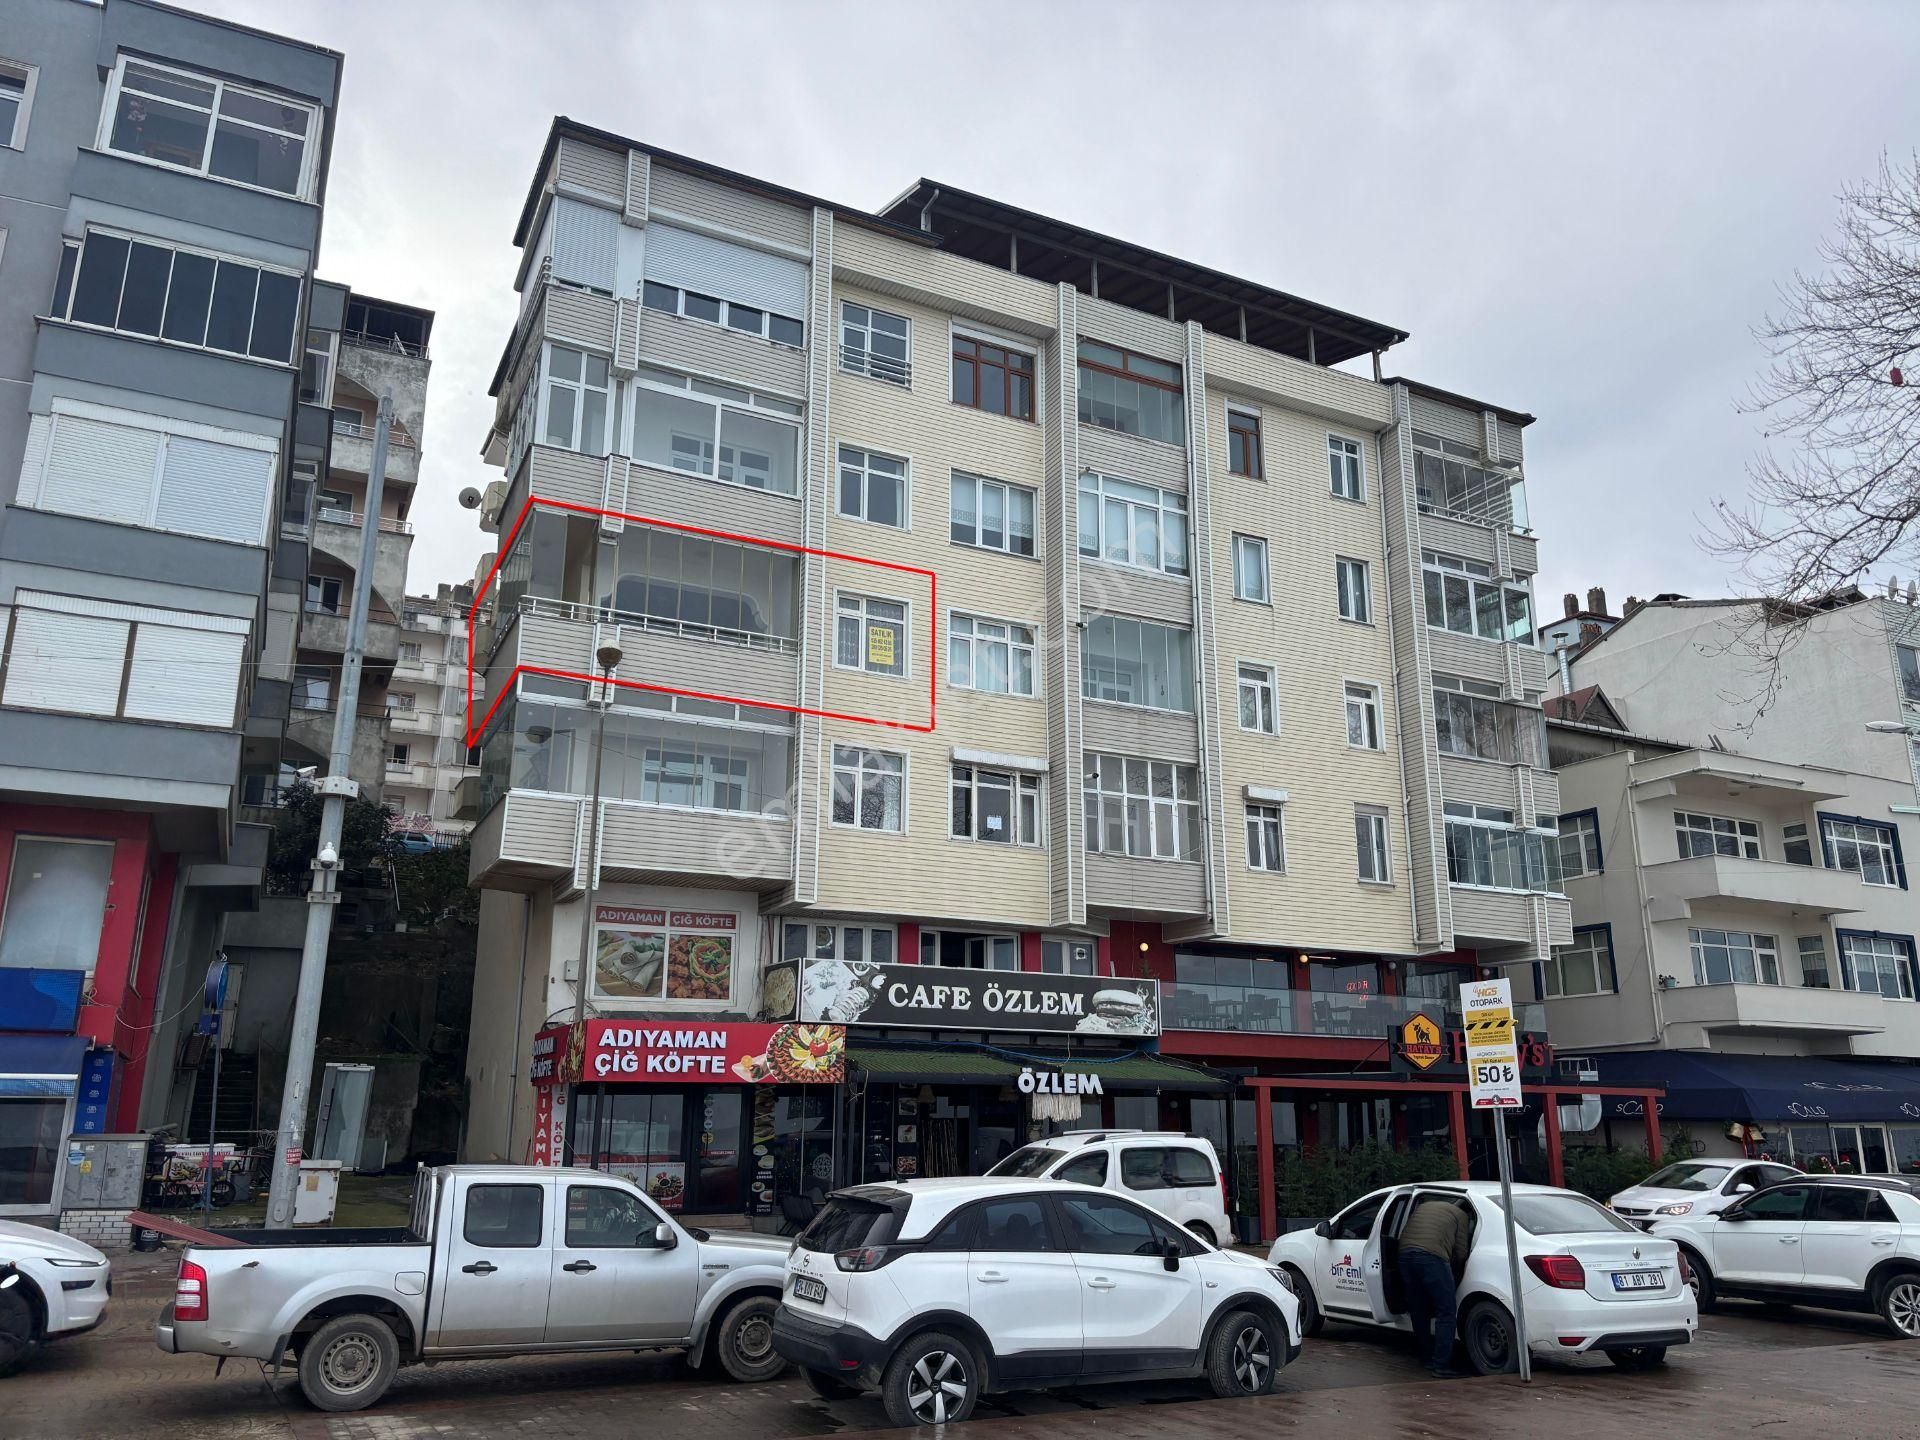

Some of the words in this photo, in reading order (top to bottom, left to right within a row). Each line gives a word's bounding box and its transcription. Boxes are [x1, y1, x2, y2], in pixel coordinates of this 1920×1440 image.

[599, 910, 662, 923] ADIYAMAN
[695, 914, 733, 927] KÖFTE
[1478, 987, 1498, 997] HGS
[888, 983, 971, 1009] CAFE
[982, 983, 1084, 1016] ÖZLEM
[1469, 997, 1503, 1007] OTOPARK
[599, 1028, 727, 1048] ADIYAMAN
[594, 1050, 639, 1076] ÇİĞ
[646, 1051, 726, 1073] KÖFTE
[1478, 1066, 1501, 1083] 50
[1017, 1068, 1103, 1095] ÖZLEM
[1331, 1264, 1343, 1276] bir
[1648, 1273, 1663, 1285] 281
